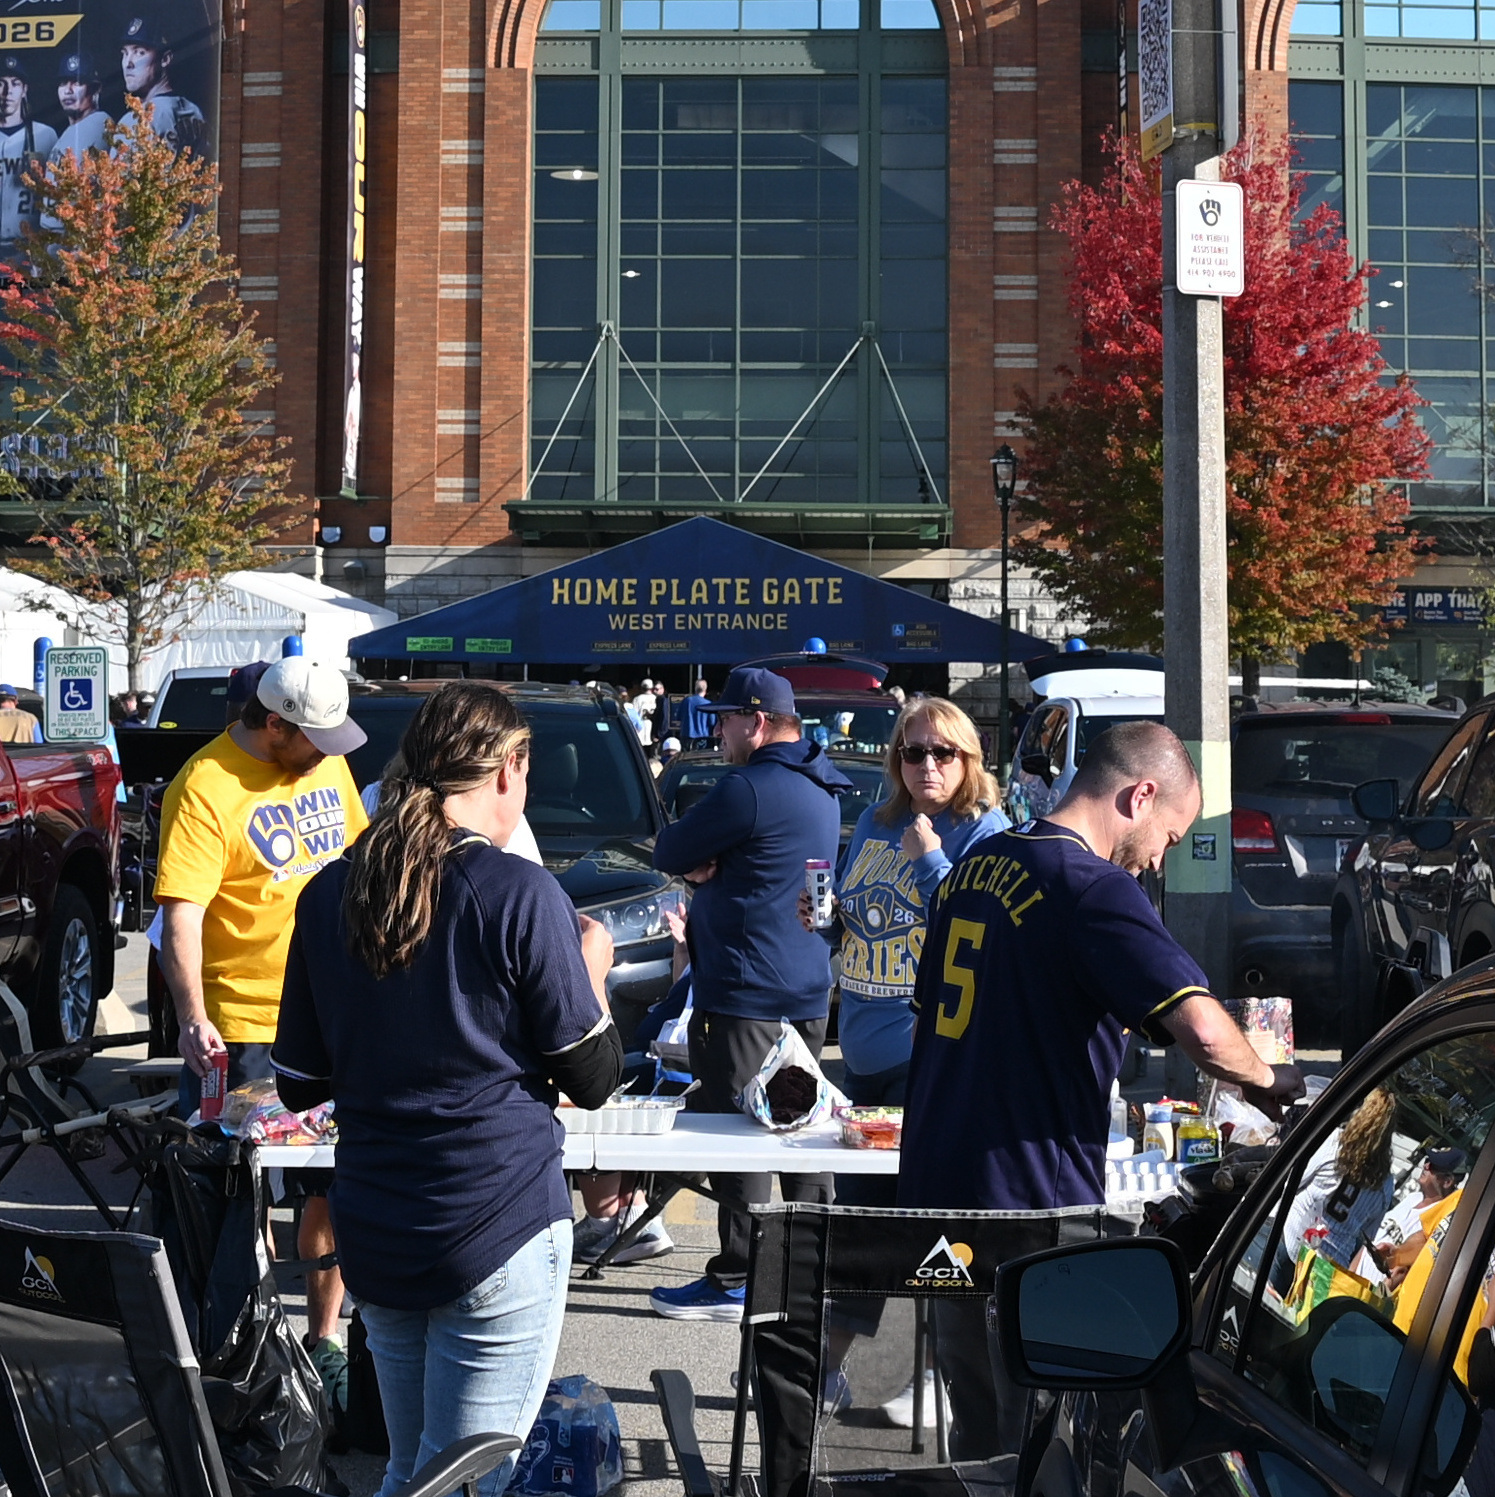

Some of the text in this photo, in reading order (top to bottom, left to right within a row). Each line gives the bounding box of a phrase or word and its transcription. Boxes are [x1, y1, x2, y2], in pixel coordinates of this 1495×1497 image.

[354, 54, 366, 109] WIN
[352, 110, 367, 264] OUR
[350, 266, 364, 342] WAY
[551, 577, 844, 605] HOME PLATE GATE
[1415, 592, 1443, 608] APP
[608, 612, 789, 630] WEST ENTRANCE
[50, 652, 102, 664] RESERVED
[54, 665, 97, 677] PARKING
[55, 727, 98, 736] THIS SPACE
[294, 788, 341, 817] WIN
[936, 855, 1044, 927] MITCHELL
[893, 909, 915, 925] 26
[841, 926, 927, 985] ERIES
[935, 917, 986, 1040] 5
[21, 1276, 53, 1292] GCI
[915, 1267, 960, 1279] GCI
